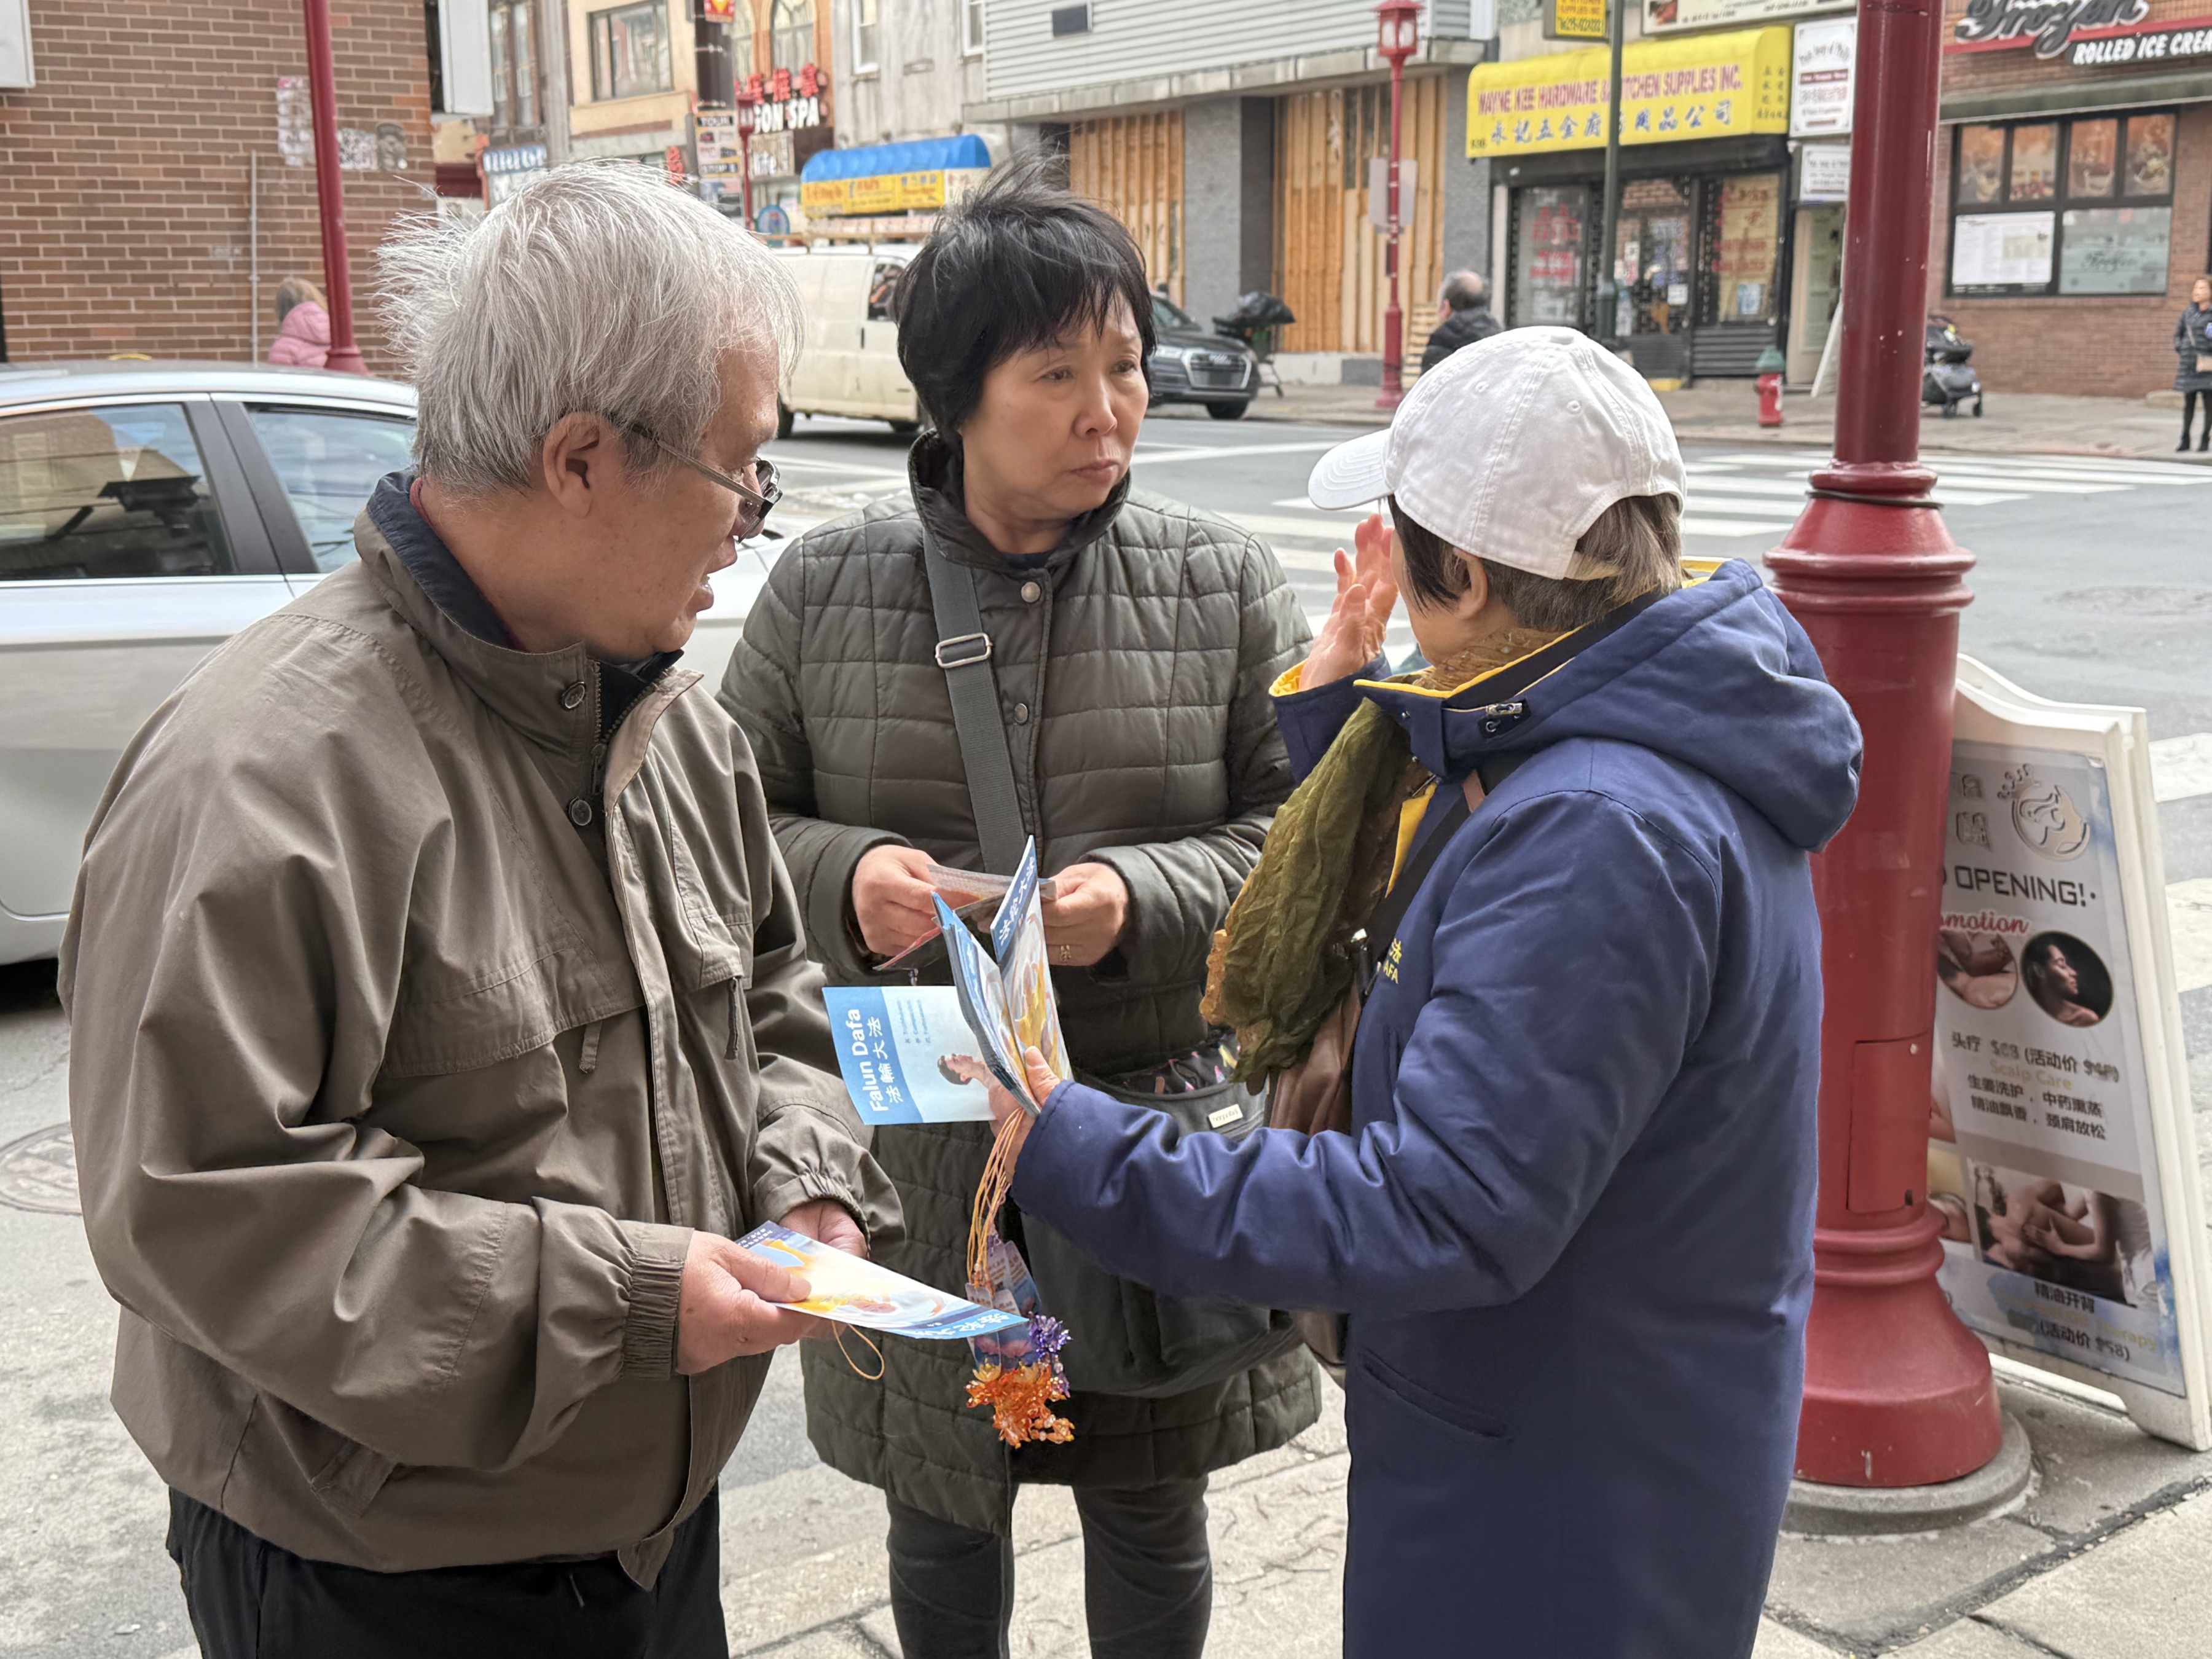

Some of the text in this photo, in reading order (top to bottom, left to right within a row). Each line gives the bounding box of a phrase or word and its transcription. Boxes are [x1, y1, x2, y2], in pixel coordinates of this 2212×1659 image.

[2072, 37, 2136, 65] ROLLED
[2137, 34, 2168, 59] ICE
[1478, 90, 1512, 115] WAYNE
[1515, 86, 1535, 112] KEE
[1538, 80, 1598, 109] HARDWARE
[1620, 73, 1660, 101] ITCHEN
[1663, 67, 1717, 96] SUPPLIES
[1719, 64, 1743, 91] INC.
[787, 96, 820, 130] SPA
[1955, 865, 2087, 908] OPENING!
[1940, 910, 2030, 935] motion
[1951, 1032, 1982, 1053] 头疗
[845, 1008, 889, 1112] Falun Dafa
[866, 1016, 904, 1104] 法輪大法
[1989, 1059, 2073, 1091] Scalp Care
[2033, 1281, 2095, 1314] 精油开背
[2093, 1317, 2157, 1353] Therapy
